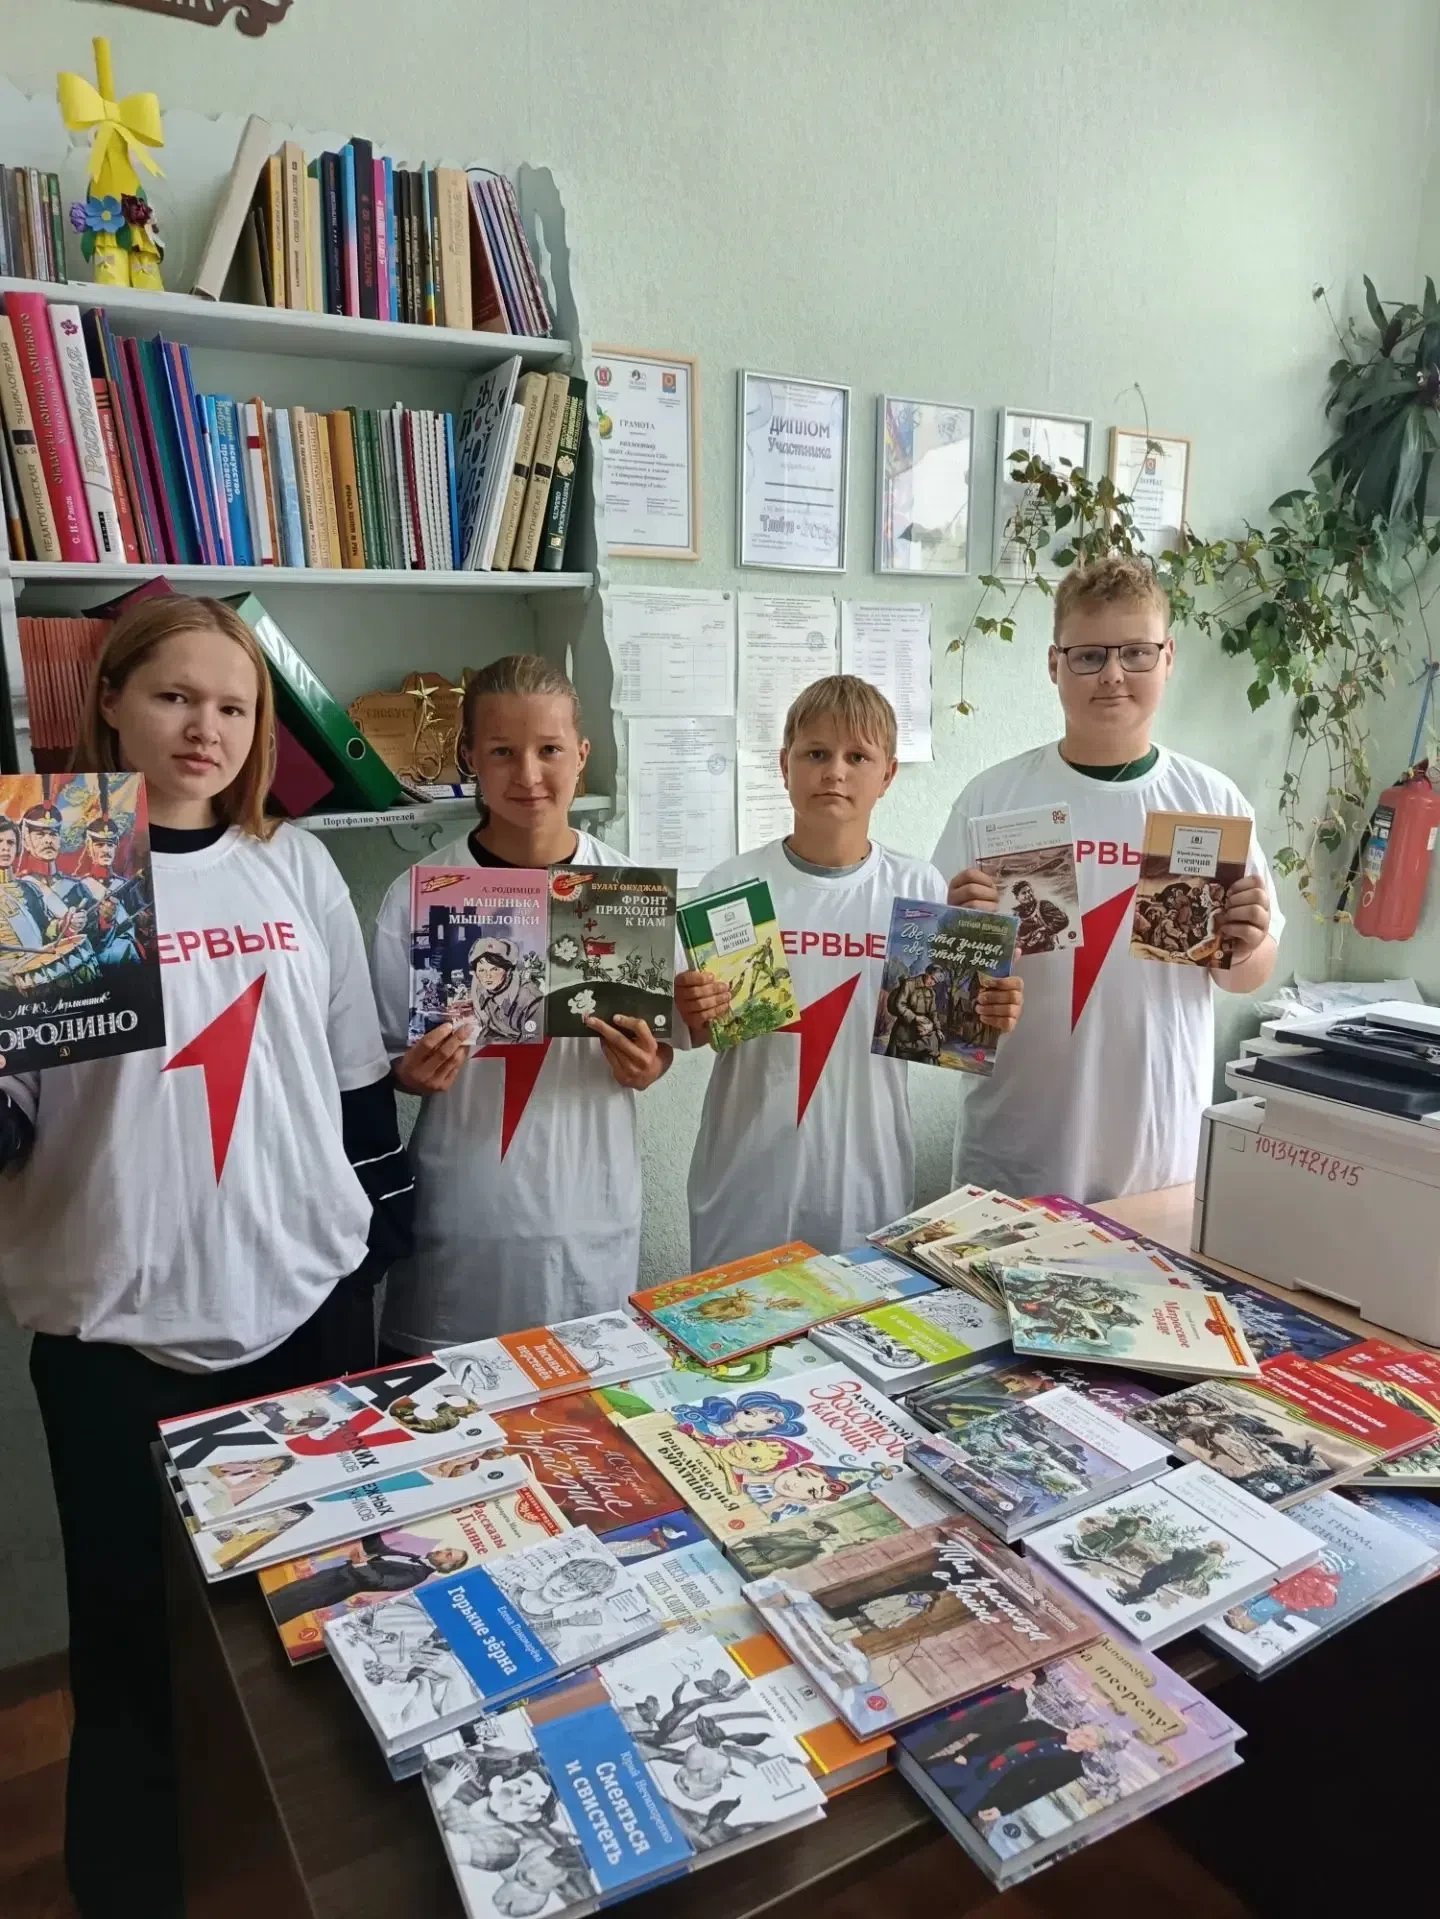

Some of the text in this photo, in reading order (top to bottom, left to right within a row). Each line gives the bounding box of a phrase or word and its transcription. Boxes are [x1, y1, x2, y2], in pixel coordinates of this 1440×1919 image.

[66, 346, 104, 476] Растения
[619, 419, 656, 431] ГРАМОТА
[769, 415, 831, 439] ДИПЛОМ
[2, 341, 54, 553] ПЕДАГОГИЧЕСКАЯ ЭНЦИКЛОПЕДИЯ
[768, 436, 832, 459] Участника
[523, 490, 544, 562] ПЕДАГОГИЧЕСКАЯ
[323, 811, 415, 827] Портфолио учителей
[463, 897, 541, 909] МАШЕНЬКА
[490, 886, 541, 895] РОДИМЦЕВ
[591, 883, 669, 892] БУЛАТ ОКУДЖАВА
[621, 895, 668, 906] ФРОНТ
[448, 913, 540, 926] МЫШЕЛОВКИ
[595, 905, 668, 917] ПРИХОДИТ
[625, 917, 666, 927] К НАМ
[158, 921, 300, 965] ЕРВЫЕ
[781, 930, 887, 960] ЕРВЫЕ
[900, 922, 924, 941] Где
[927, 933, 957, 948] эта
[902, 941, 1000, 970] где этот дом
[0, 1009, 139, 1053] ОРОДИНО
[1255, 1136, 1365, 1186] 10134721815
[505, 1428, 606, 1513] трагедии
[530, 1407, 633, 1519] Маленькие
[361, 1482, 396, 1517] ЕЖНЫХ
[456, 1513, 489, 1556] Глинке
[469, 1500, 507, 1549] Рассказы
[643, 1570, 703, 1636] ШЕСТЬ КАПИТАНОВ
[661, 1557, 712, 1608] ШЕСТЬ ИВАНОВ
[946, 1582, 1001, 1625] войне
[497, 1604, 516, 1626] Елена
[960, 1576, 1052, 1642] рассказа
[447, 1585, 519, 1677] Горькие зёрна
[1094, 1664, 1180, 1734] теорему!
[565, 1759, 623, 1866] и свистеть
[595, 1761, 652, 1857] Смеяться
